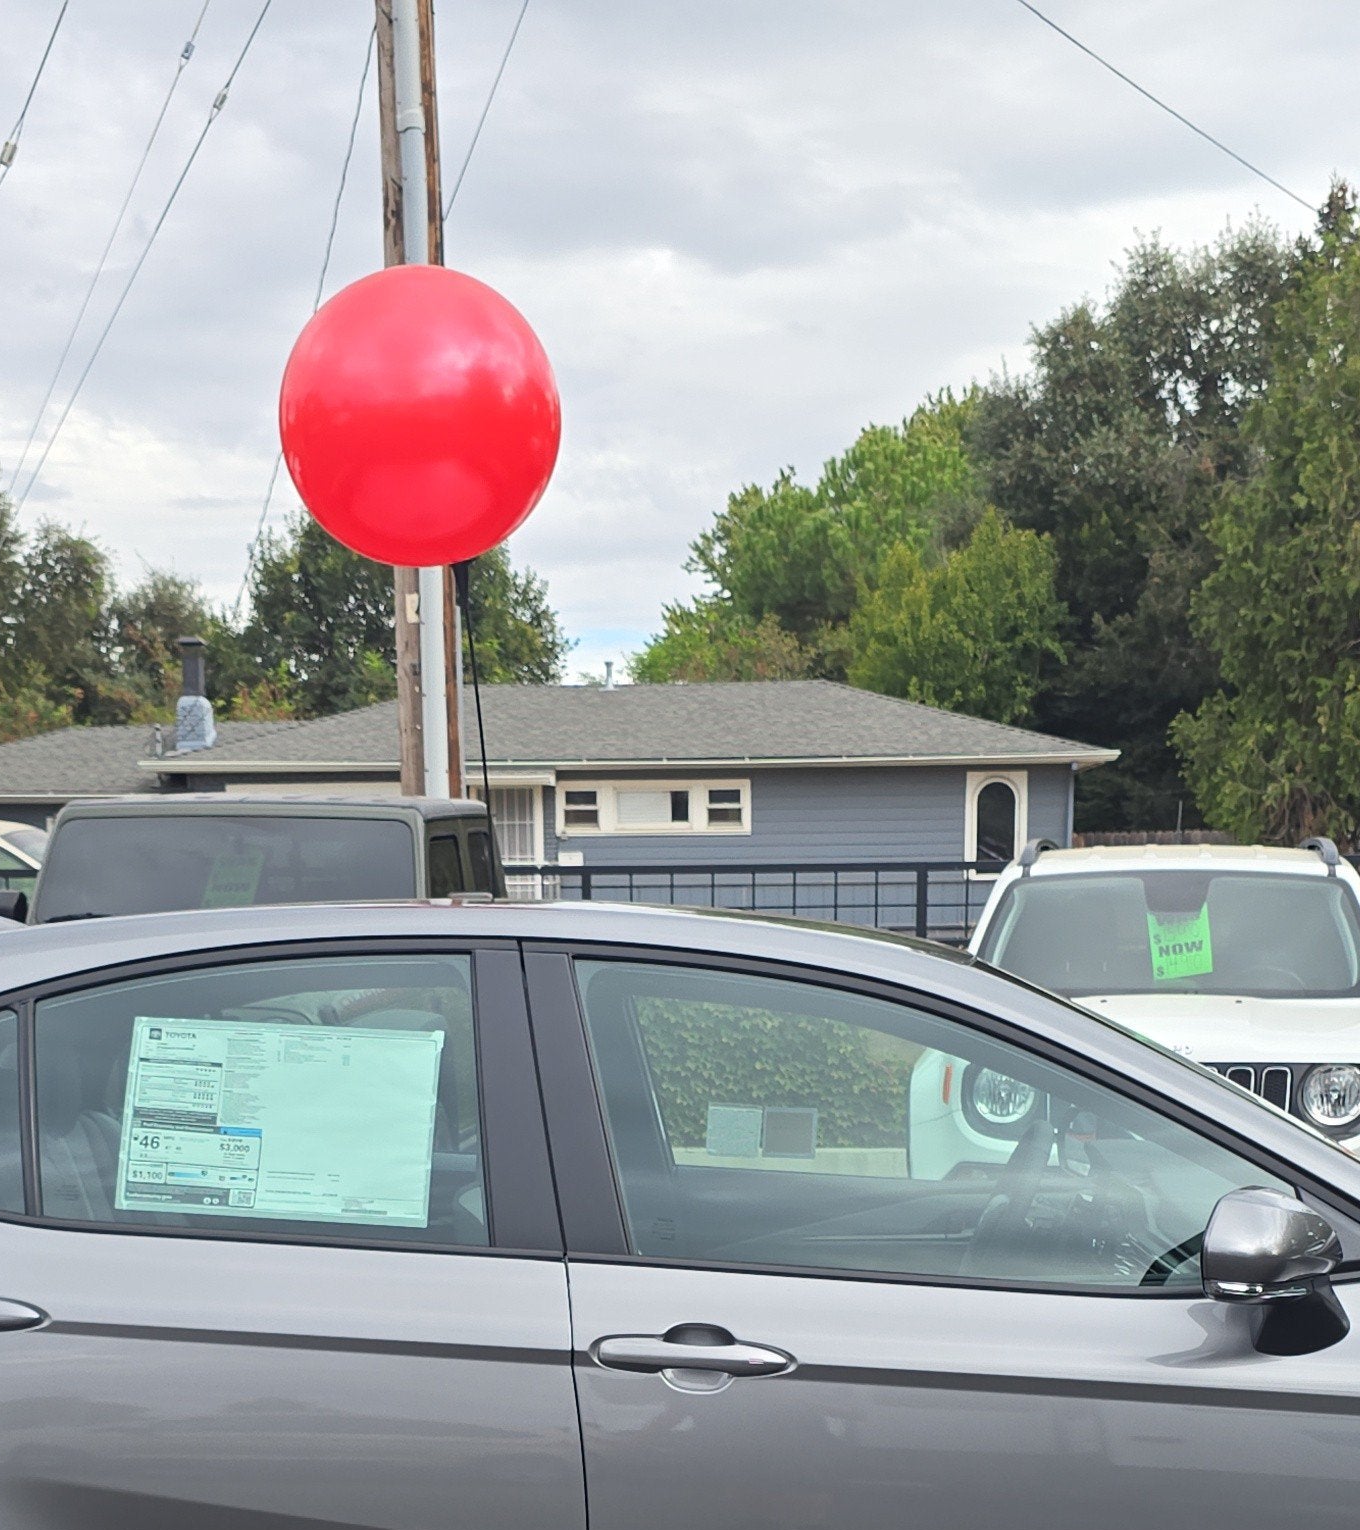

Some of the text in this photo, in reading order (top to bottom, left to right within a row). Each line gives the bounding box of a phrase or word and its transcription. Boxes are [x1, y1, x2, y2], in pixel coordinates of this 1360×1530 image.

[1158, 940, 1203, 958] NOW
[165, 1031, 197, 1040] TOYOTA
[140, 1134, 160, 1150] 46
